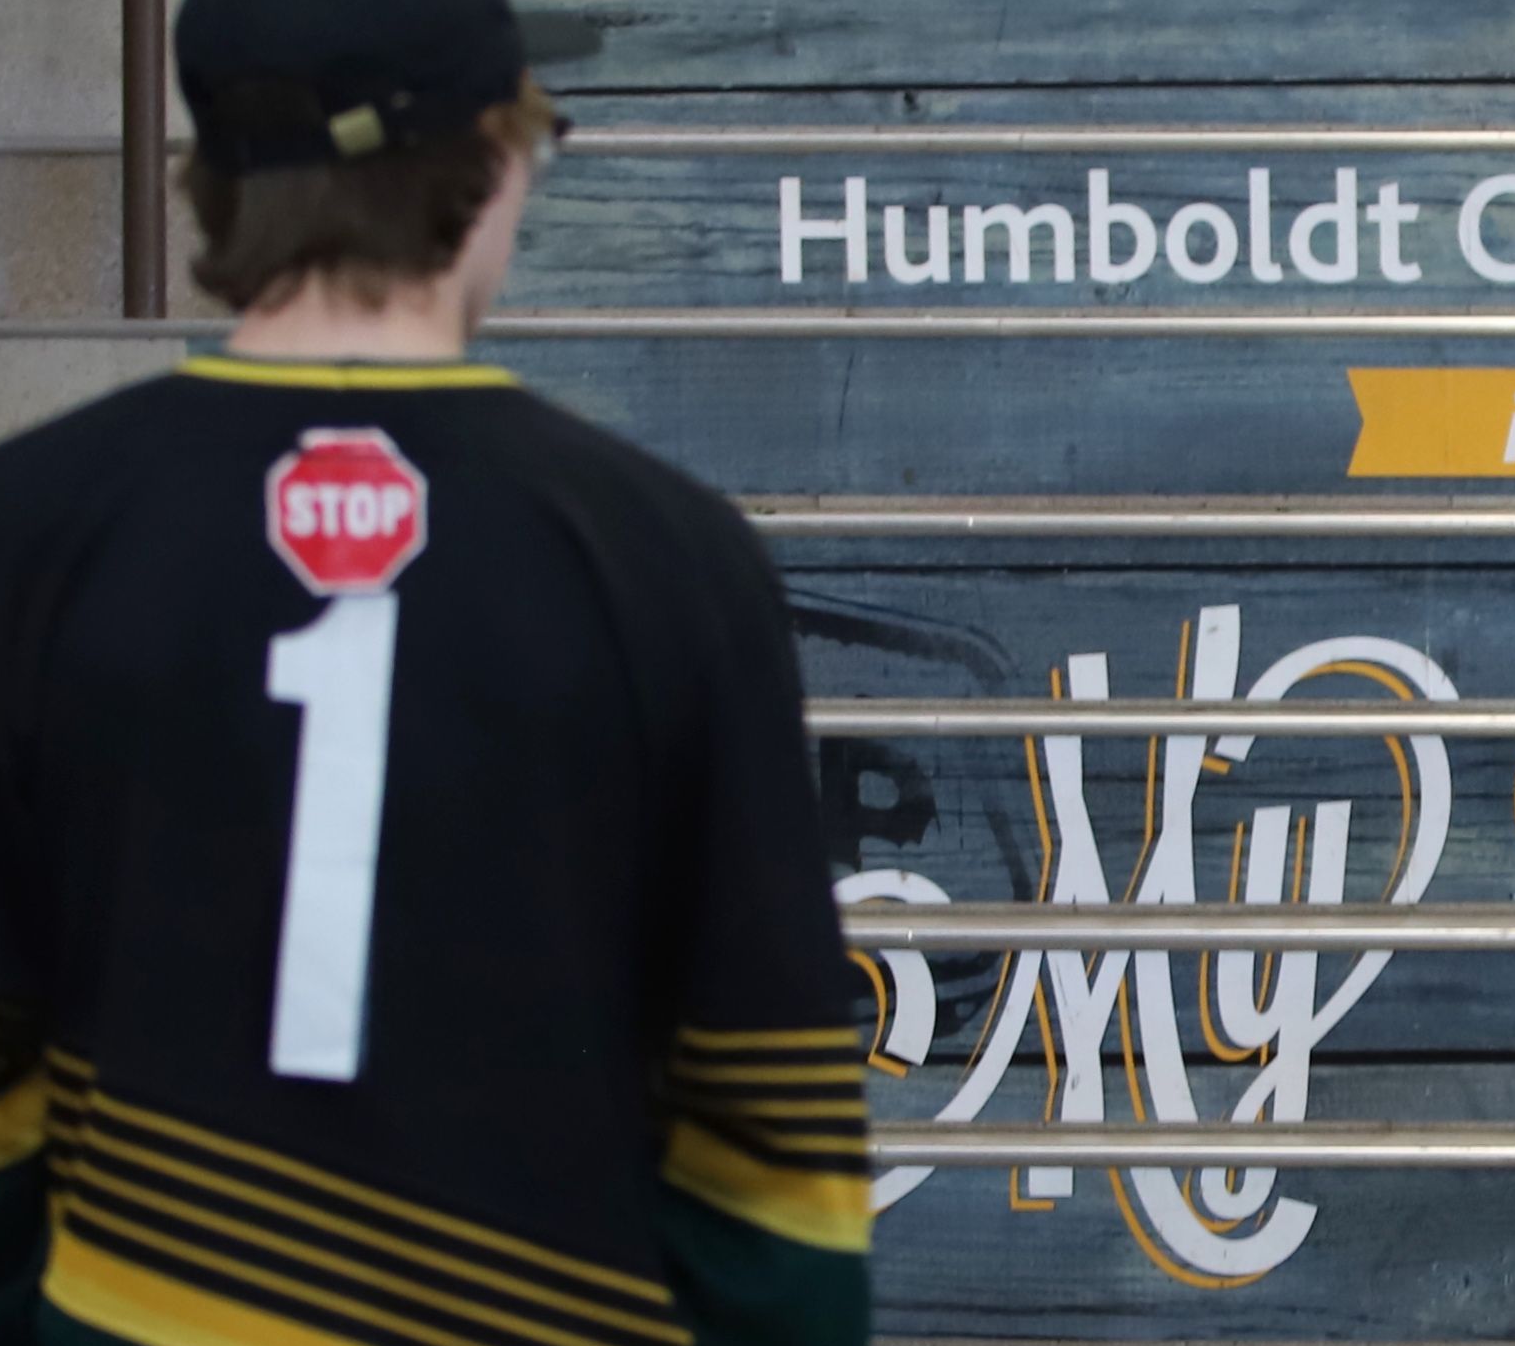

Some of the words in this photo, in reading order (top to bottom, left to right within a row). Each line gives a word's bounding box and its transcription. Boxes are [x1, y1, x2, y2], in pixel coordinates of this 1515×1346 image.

[778, 167, 1420, 285] Humboldt
[283, 483, 415, 539] STOP
[266, 593, 399, 1083] 1
